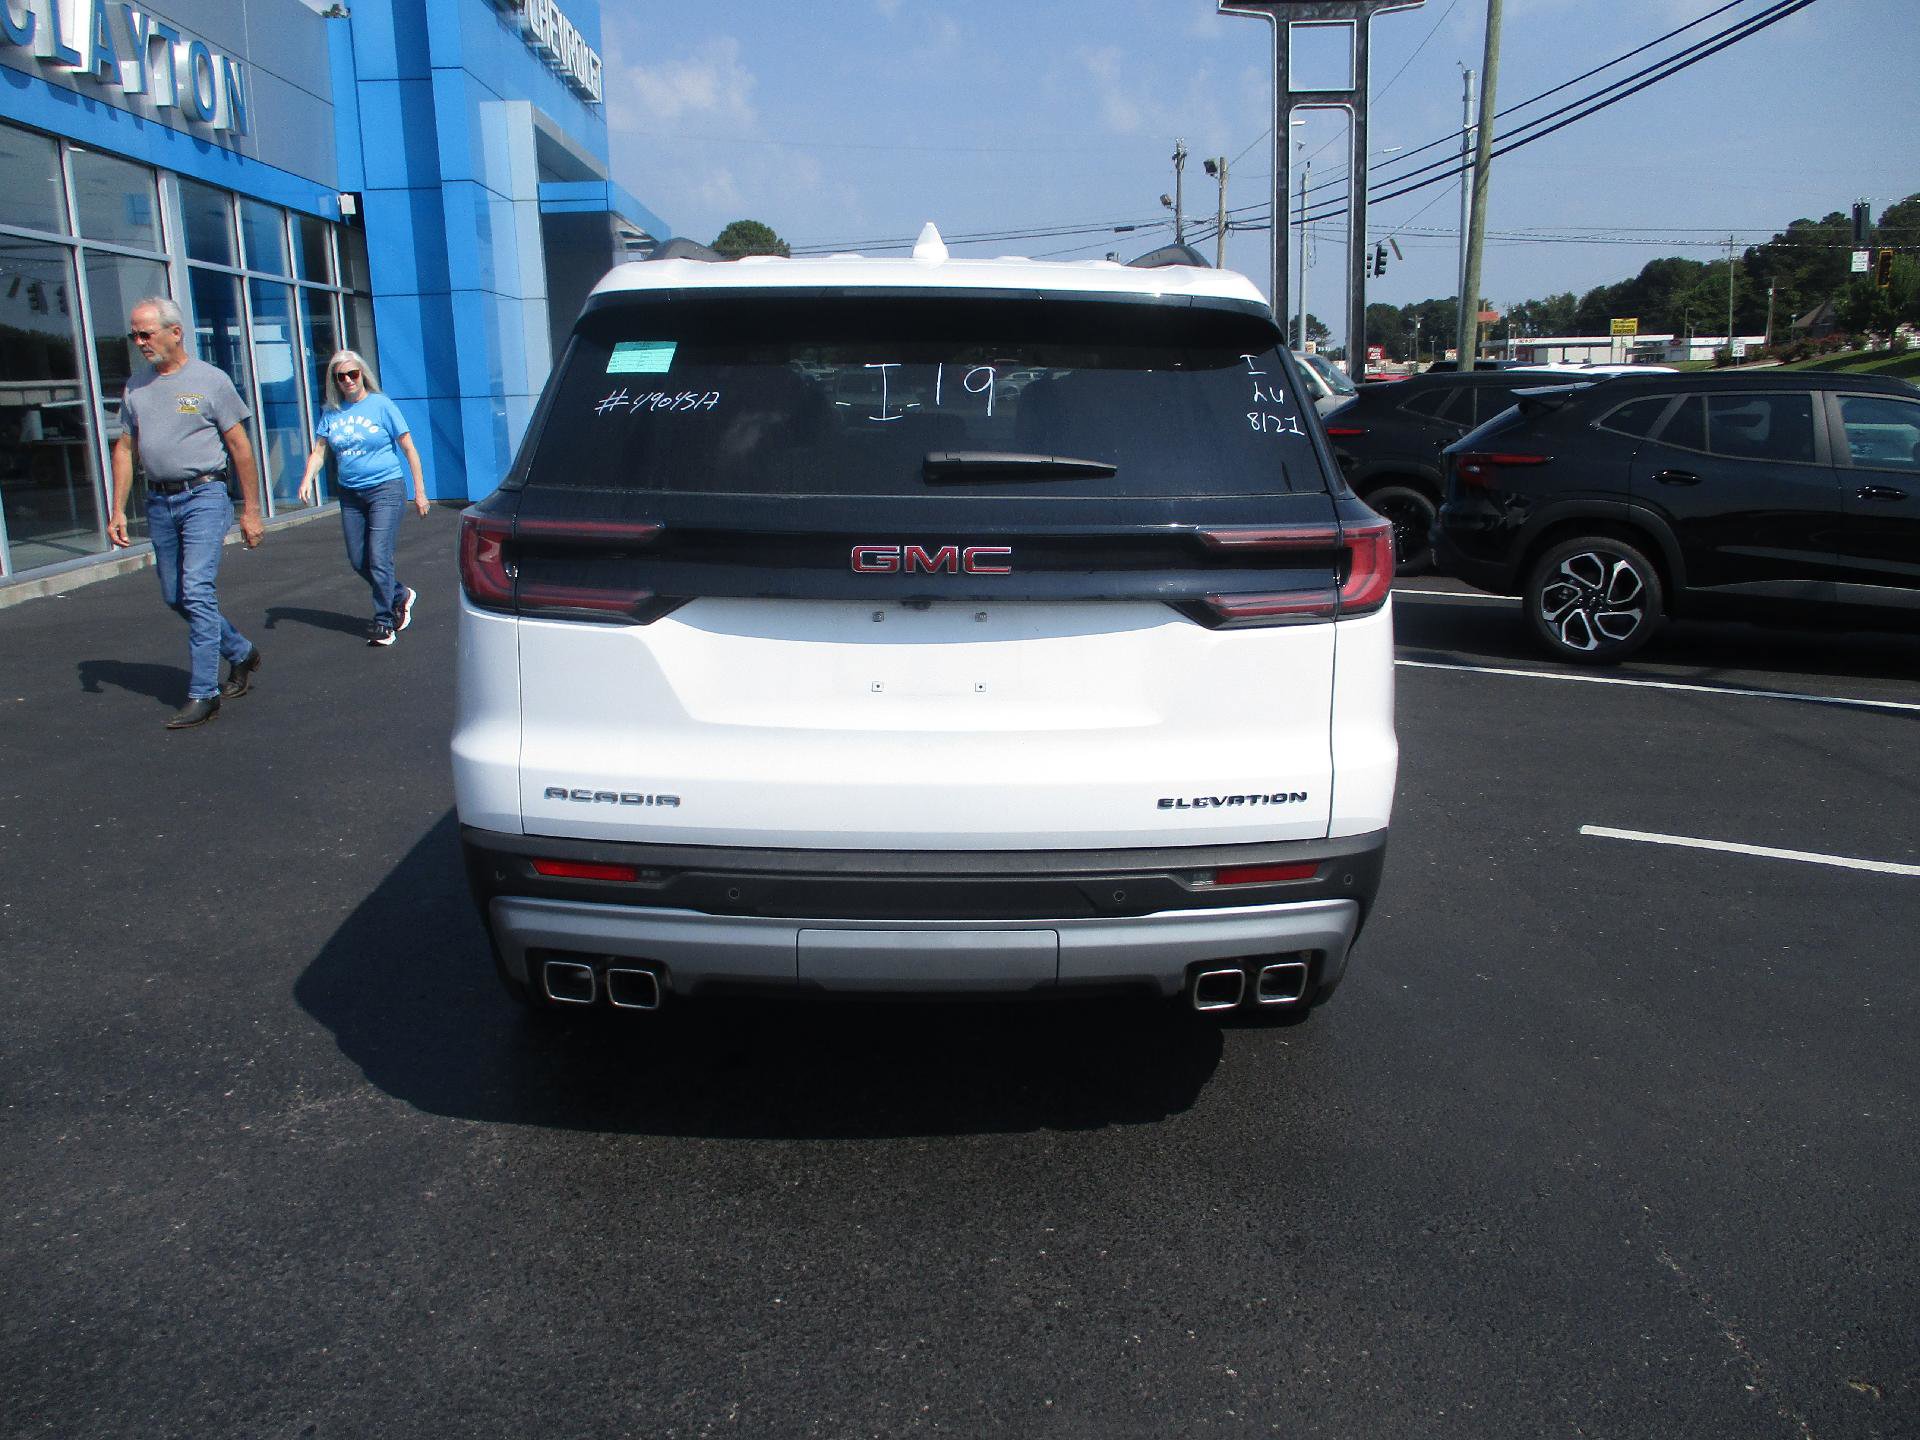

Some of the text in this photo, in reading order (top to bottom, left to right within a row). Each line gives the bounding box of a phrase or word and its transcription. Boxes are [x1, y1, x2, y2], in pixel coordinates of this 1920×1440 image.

[328, 415, 379, 437] RLANDO
[851, 545, 1012, 575] GMC
[544, 786, 681, 808] ACADIA
[1156, 791, 1308, 810] ELEVATION
